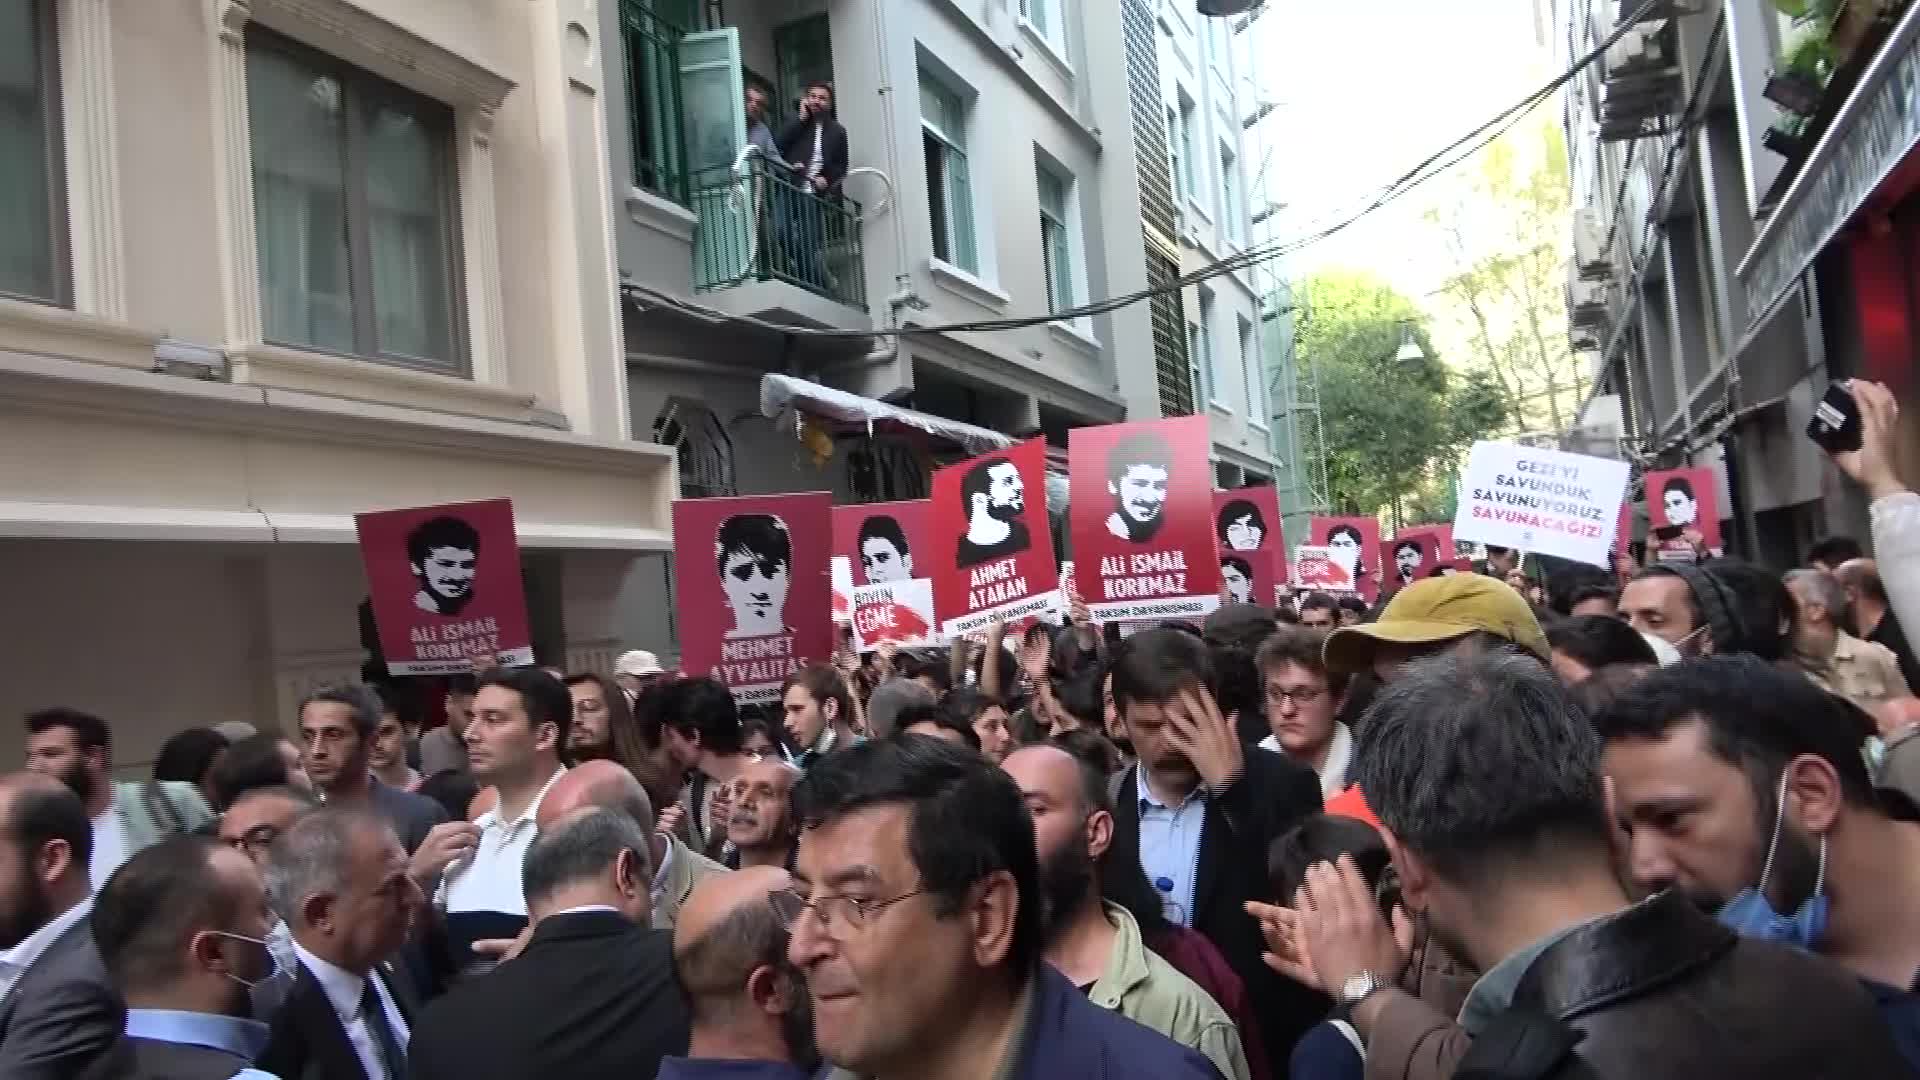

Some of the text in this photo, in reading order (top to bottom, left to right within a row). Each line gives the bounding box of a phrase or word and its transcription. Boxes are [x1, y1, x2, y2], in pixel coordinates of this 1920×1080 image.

[970, 558, 1017, 587] AHMET
[854, 587, 894, 610] BOYUN
[968, 576, 1028, 610] ATAKAN
[1104, 573, 1188, 599] KORKMAZ
[415, 634, 501, 660] KORKMAZ
[720, 636, 794, 662] MEHMET
